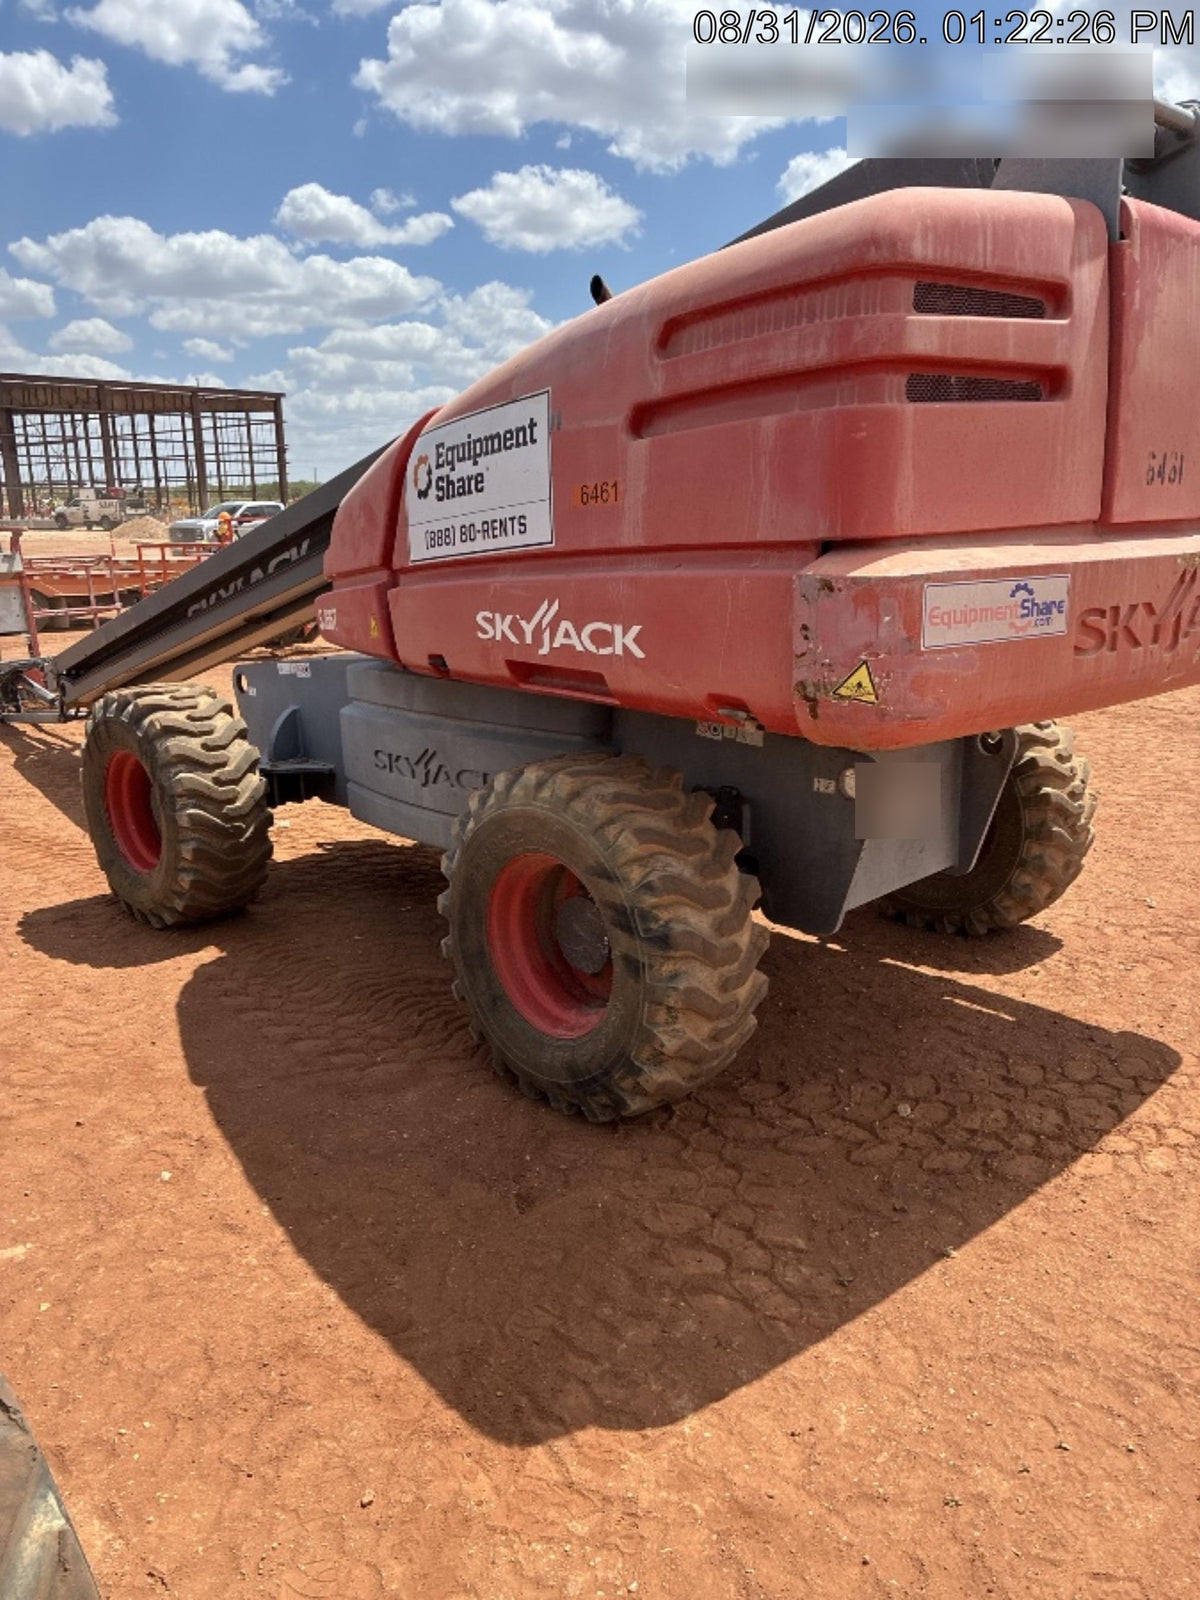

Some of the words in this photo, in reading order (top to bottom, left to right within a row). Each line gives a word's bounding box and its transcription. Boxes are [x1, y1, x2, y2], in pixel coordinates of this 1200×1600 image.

[434, 417, 538, 471] Equipment
[434, 471, 485, 502] Share
[580, 481, 620, 506] 6461
[425, 525, 456, 549] (888)
[459, 515, 527, 543] 80-RENTS
[475, 597, 646, 659] SKYJACK
